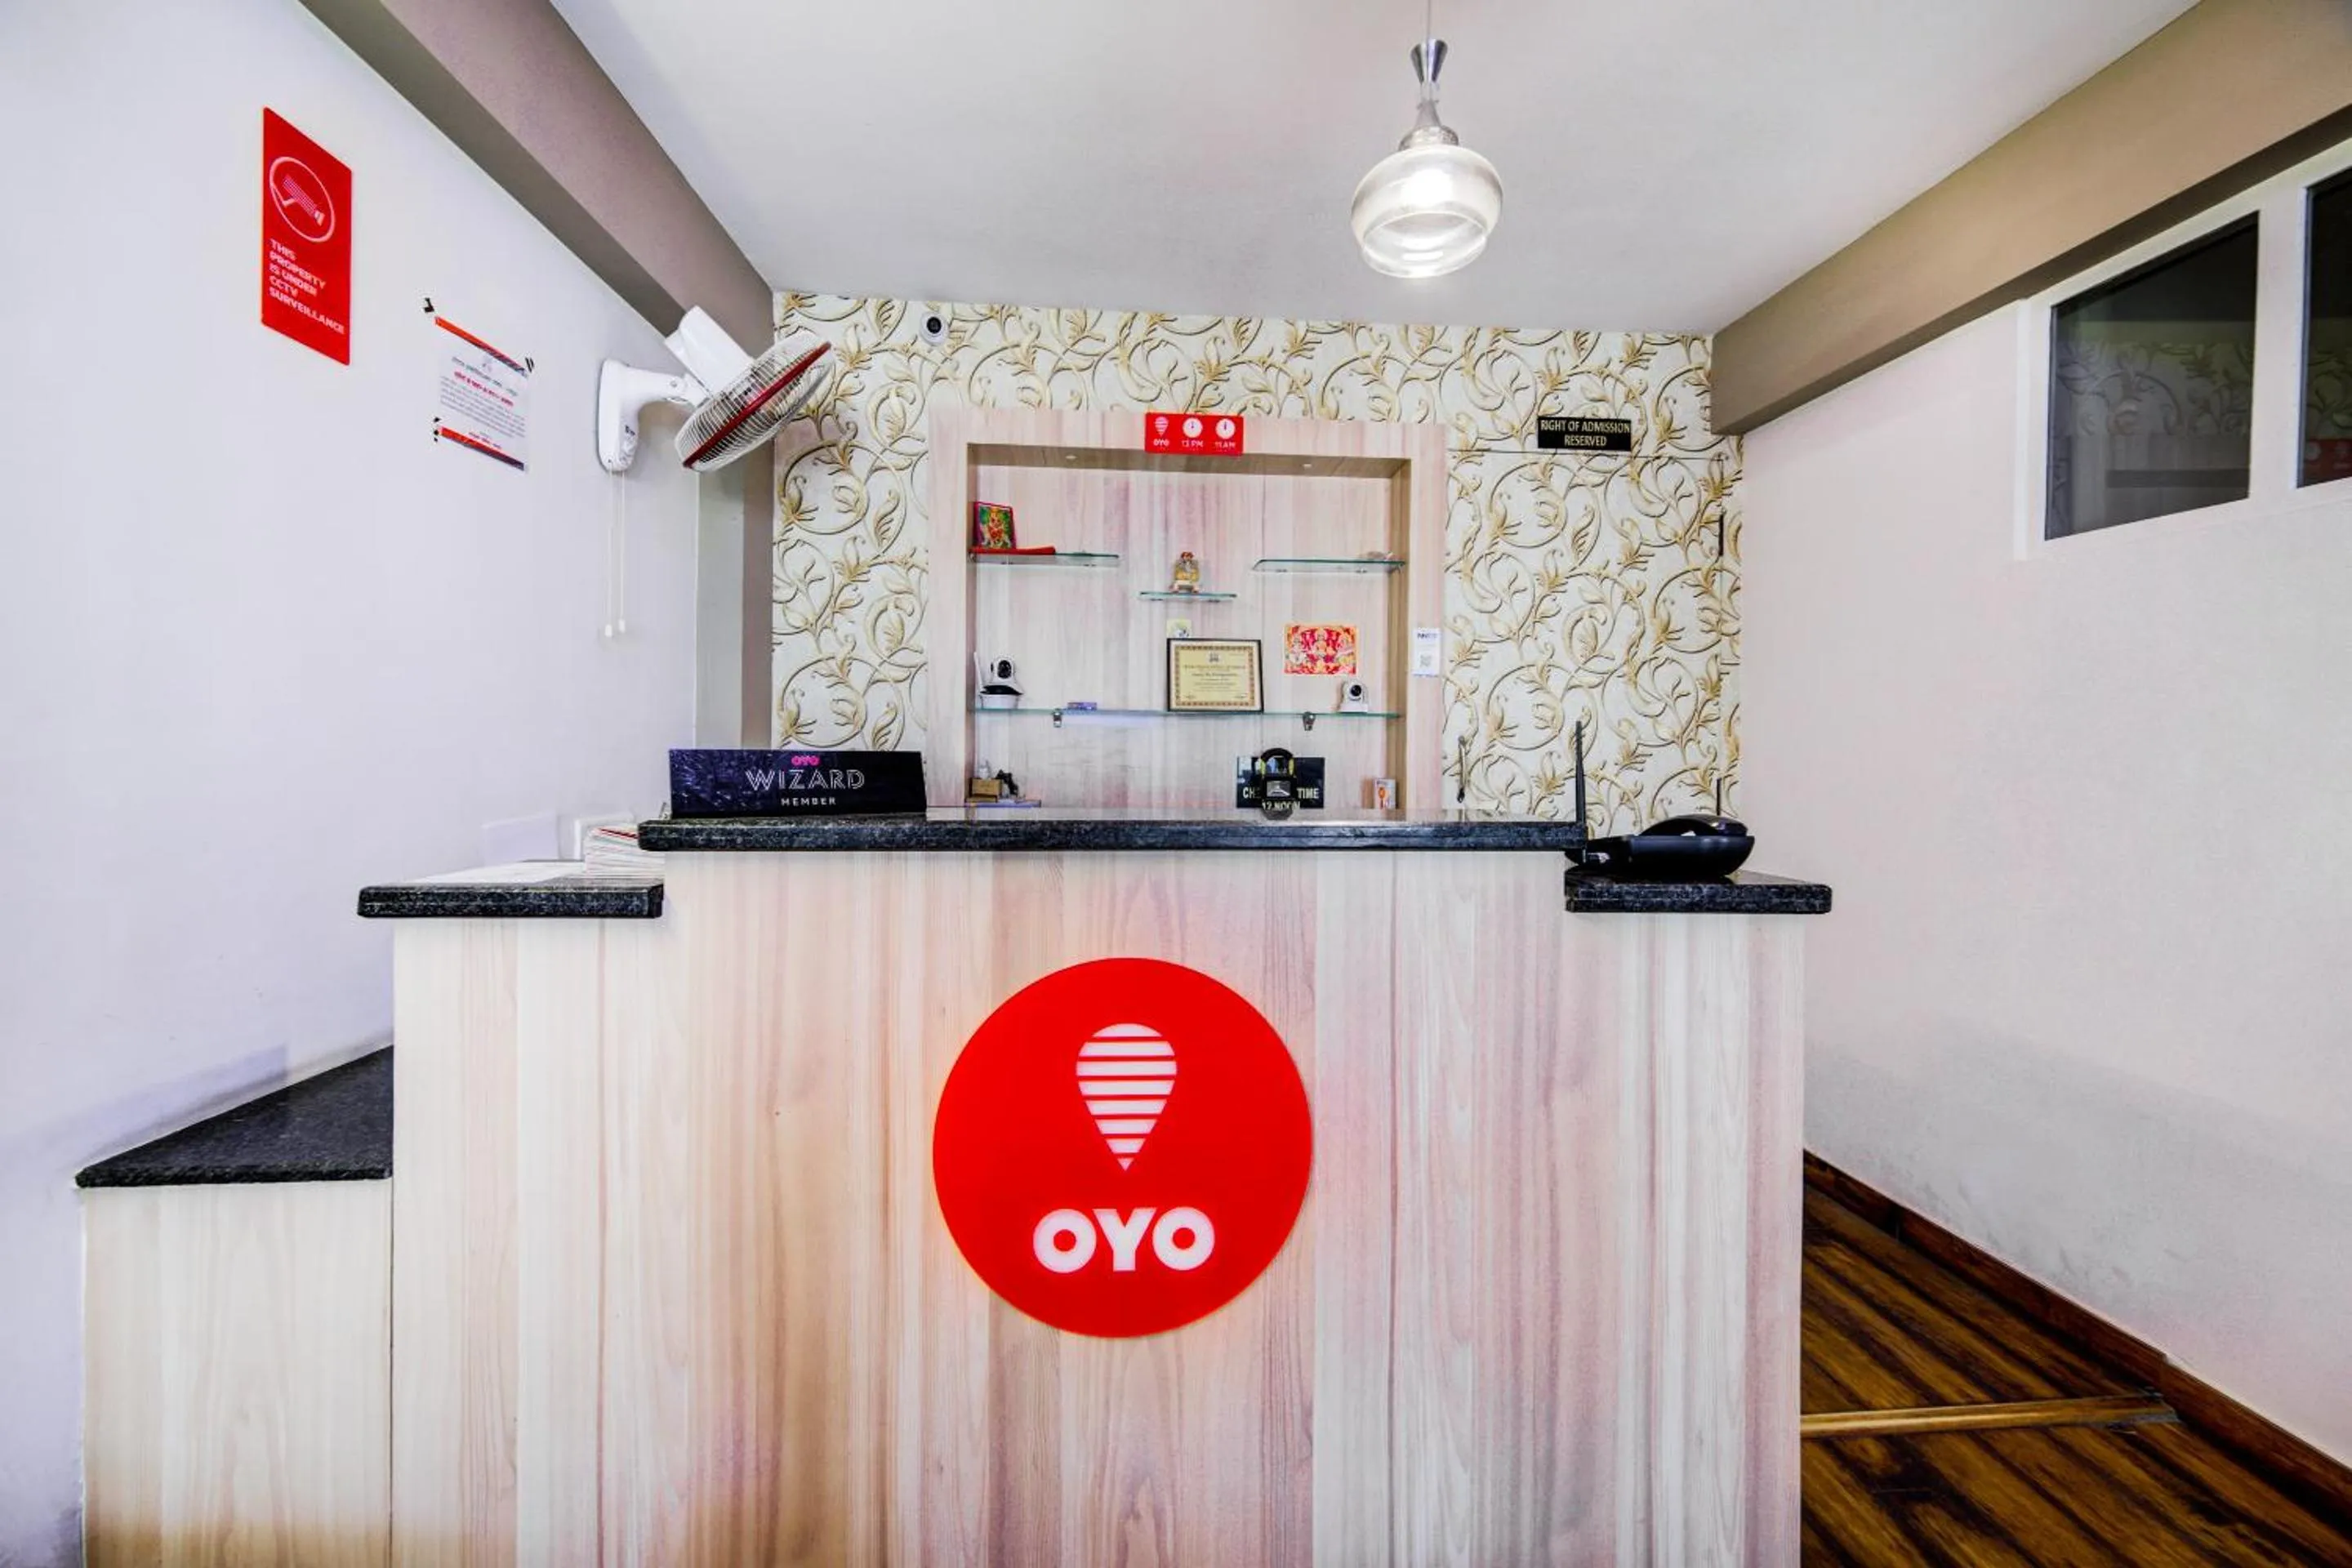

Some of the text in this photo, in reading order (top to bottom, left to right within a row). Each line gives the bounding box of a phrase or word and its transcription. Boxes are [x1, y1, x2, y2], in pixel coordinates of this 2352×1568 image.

[270, 238, 296, 261] THIS
[270, 251, 326, 289] PROPERTY
[270, 275, 298, 297] CCTV
[282, 270, 317, 296] UNDER
[270, 287, 345, 334] SURVEILLANCE
[1540, 419, 1630, 434] RIGHT OF ADMISSION
[1564, 434, 1607, 446] RESERVED
[746, 768, 865, 791] WIZARD
[781, 795, 837, 807] MEMBER
[1296, 788, 1320, 799] TIME
[1033, 1206, 1215, 1273] OYO
